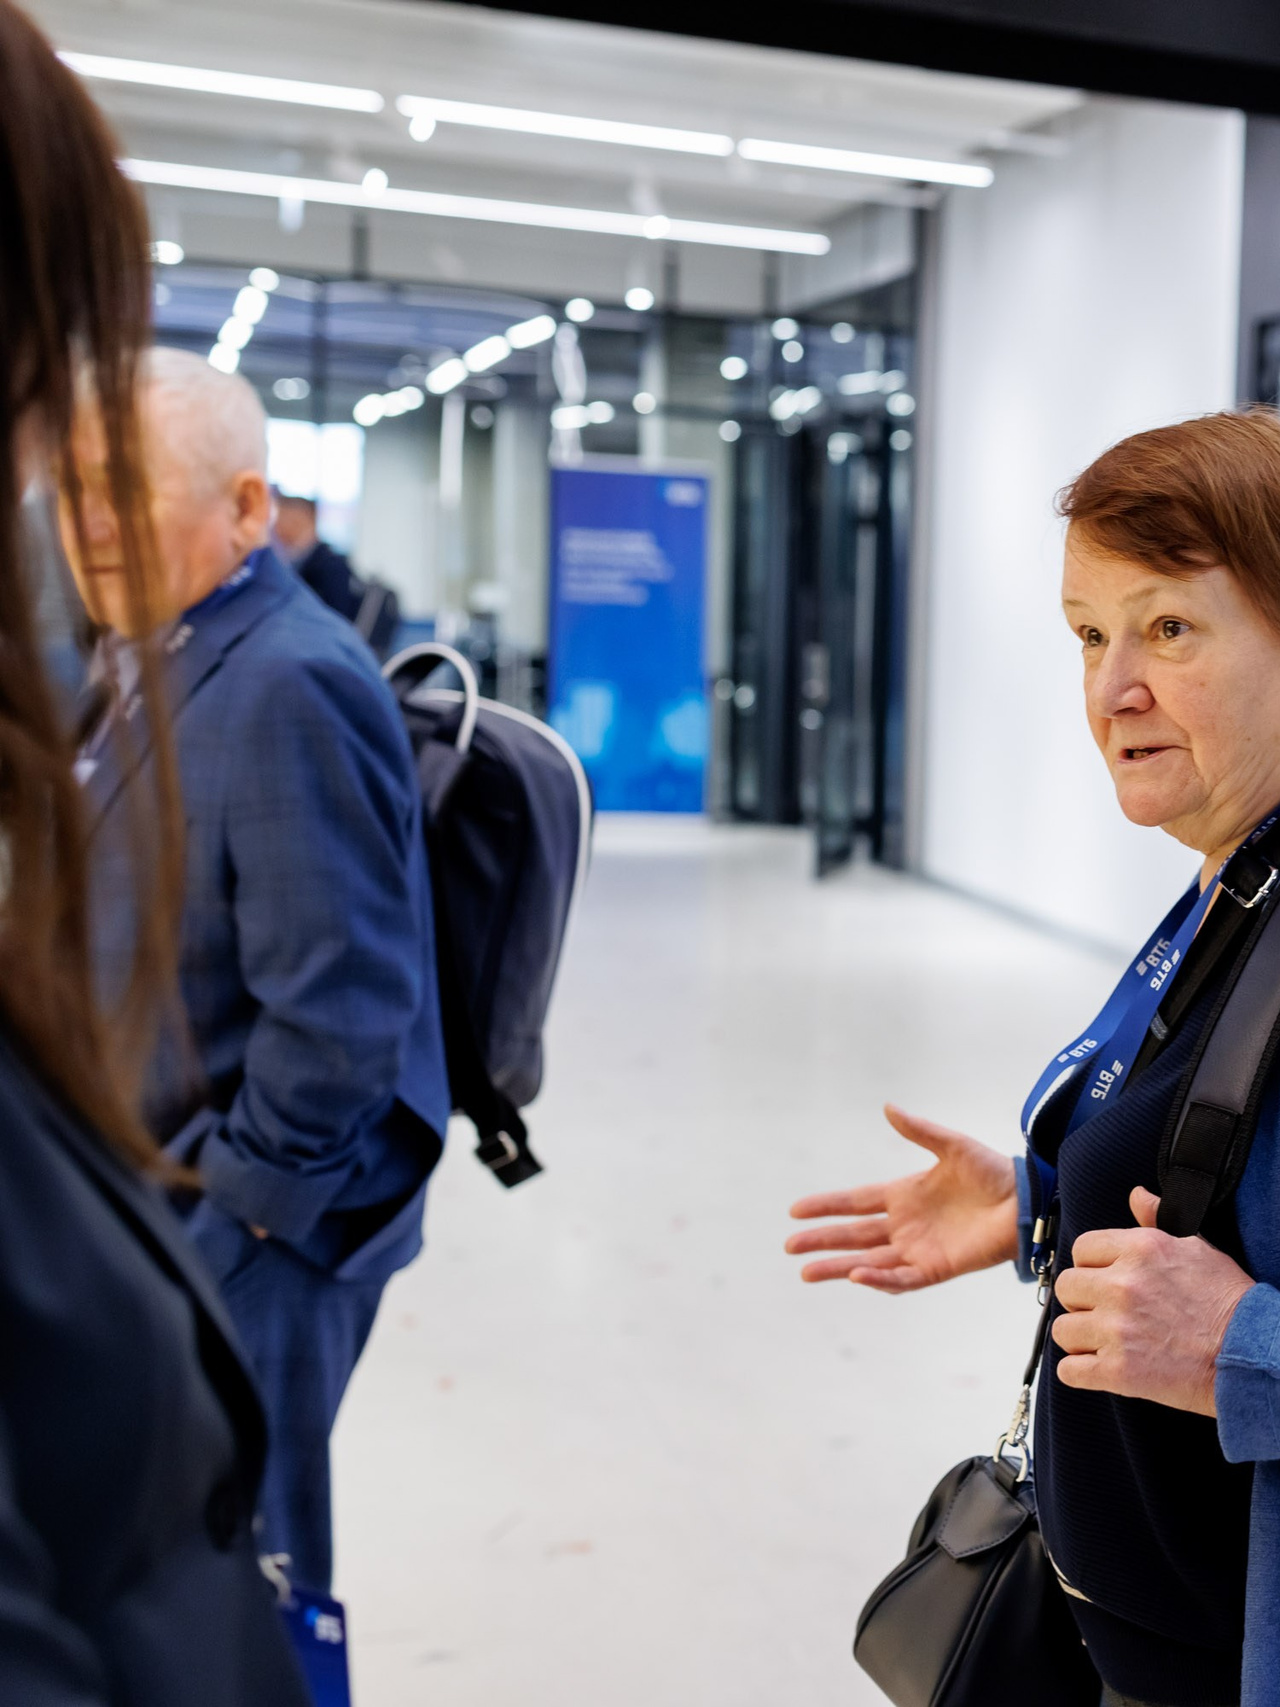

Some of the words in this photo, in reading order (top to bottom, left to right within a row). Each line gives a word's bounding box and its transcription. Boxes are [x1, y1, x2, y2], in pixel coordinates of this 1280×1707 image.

[1146, 938, 1170, 967] ВТБ
[1150, 959, 1173, 991] ВТБ
[1068, 1038, 1098, 1058] ВТБ
[1091, 1069, 1116, 1100] ВТБ
